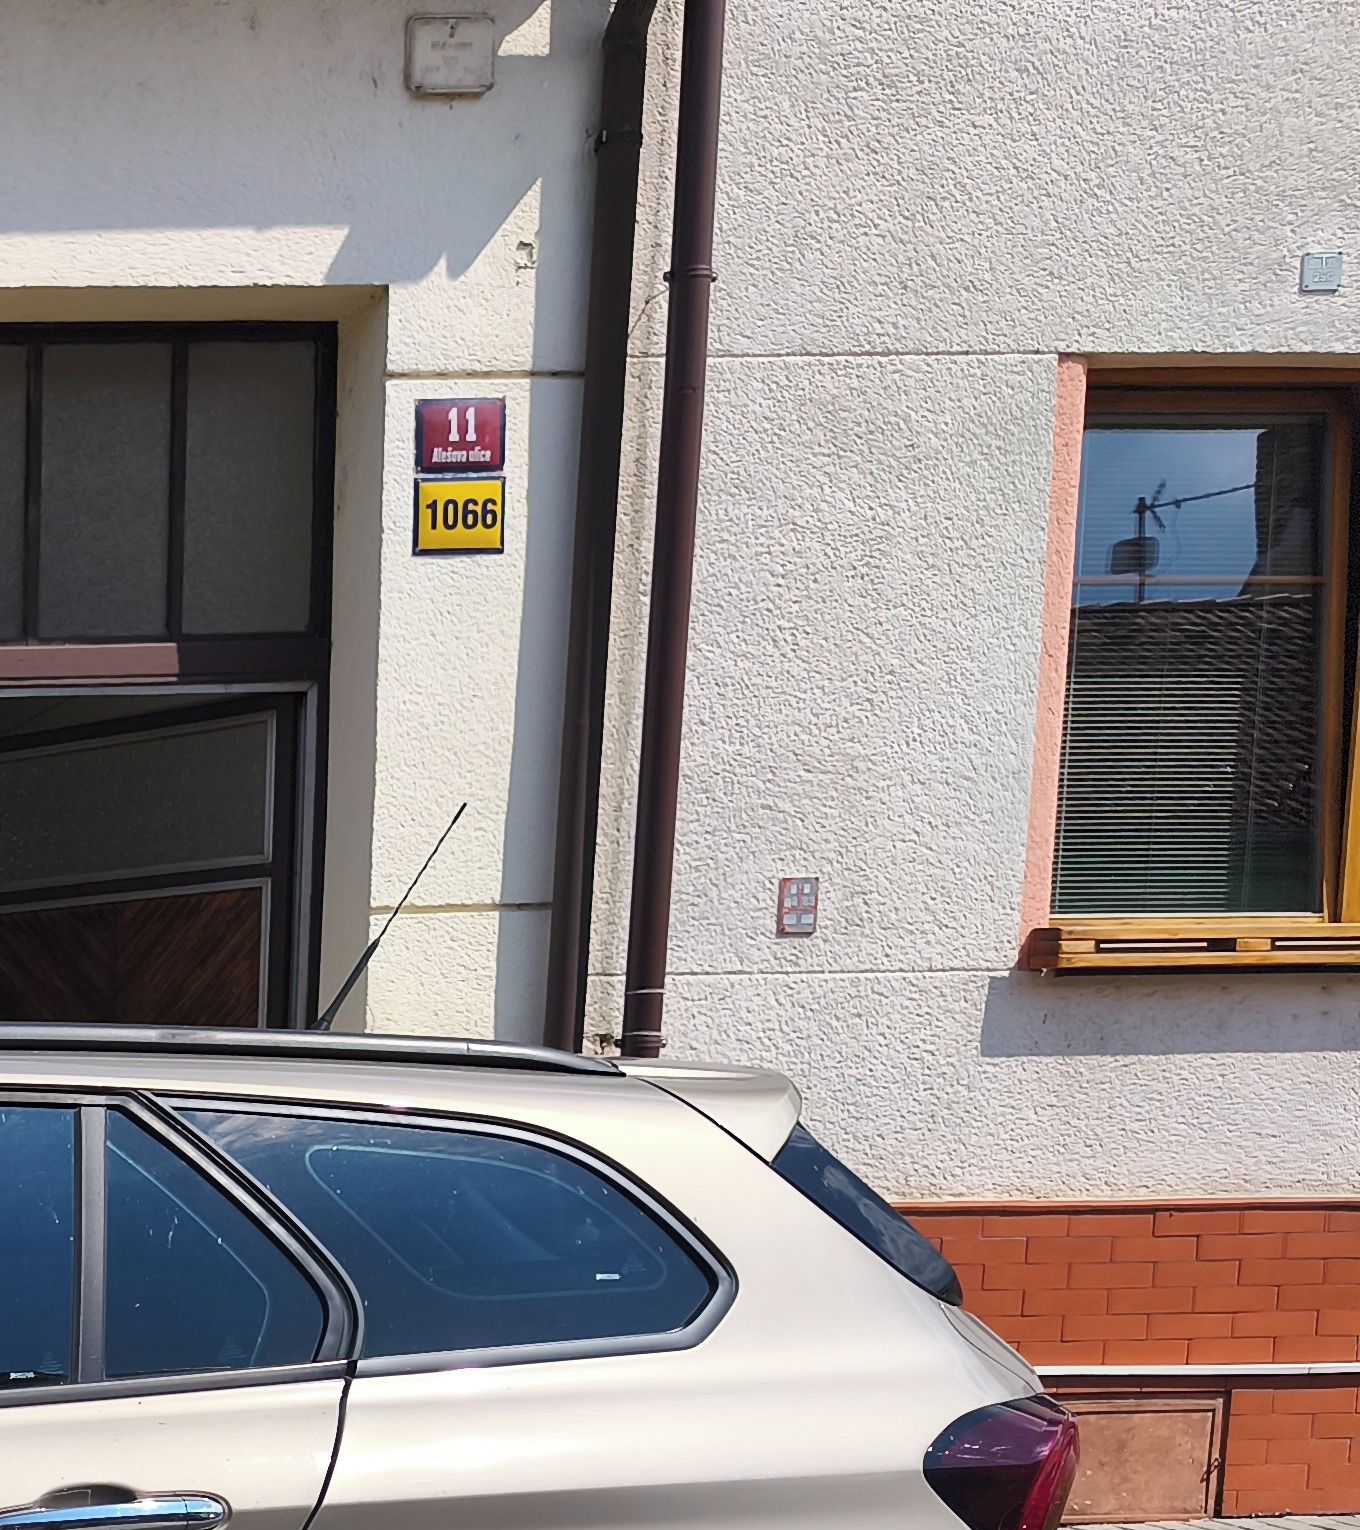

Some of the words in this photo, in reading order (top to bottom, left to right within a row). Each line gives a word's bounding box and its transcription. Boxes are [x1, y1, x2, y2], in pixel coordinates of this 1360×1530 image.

[448, 406, 477, 442] 11
[468, 446, 492, 462] ulice
[425, 498, 498, 531] 1066
